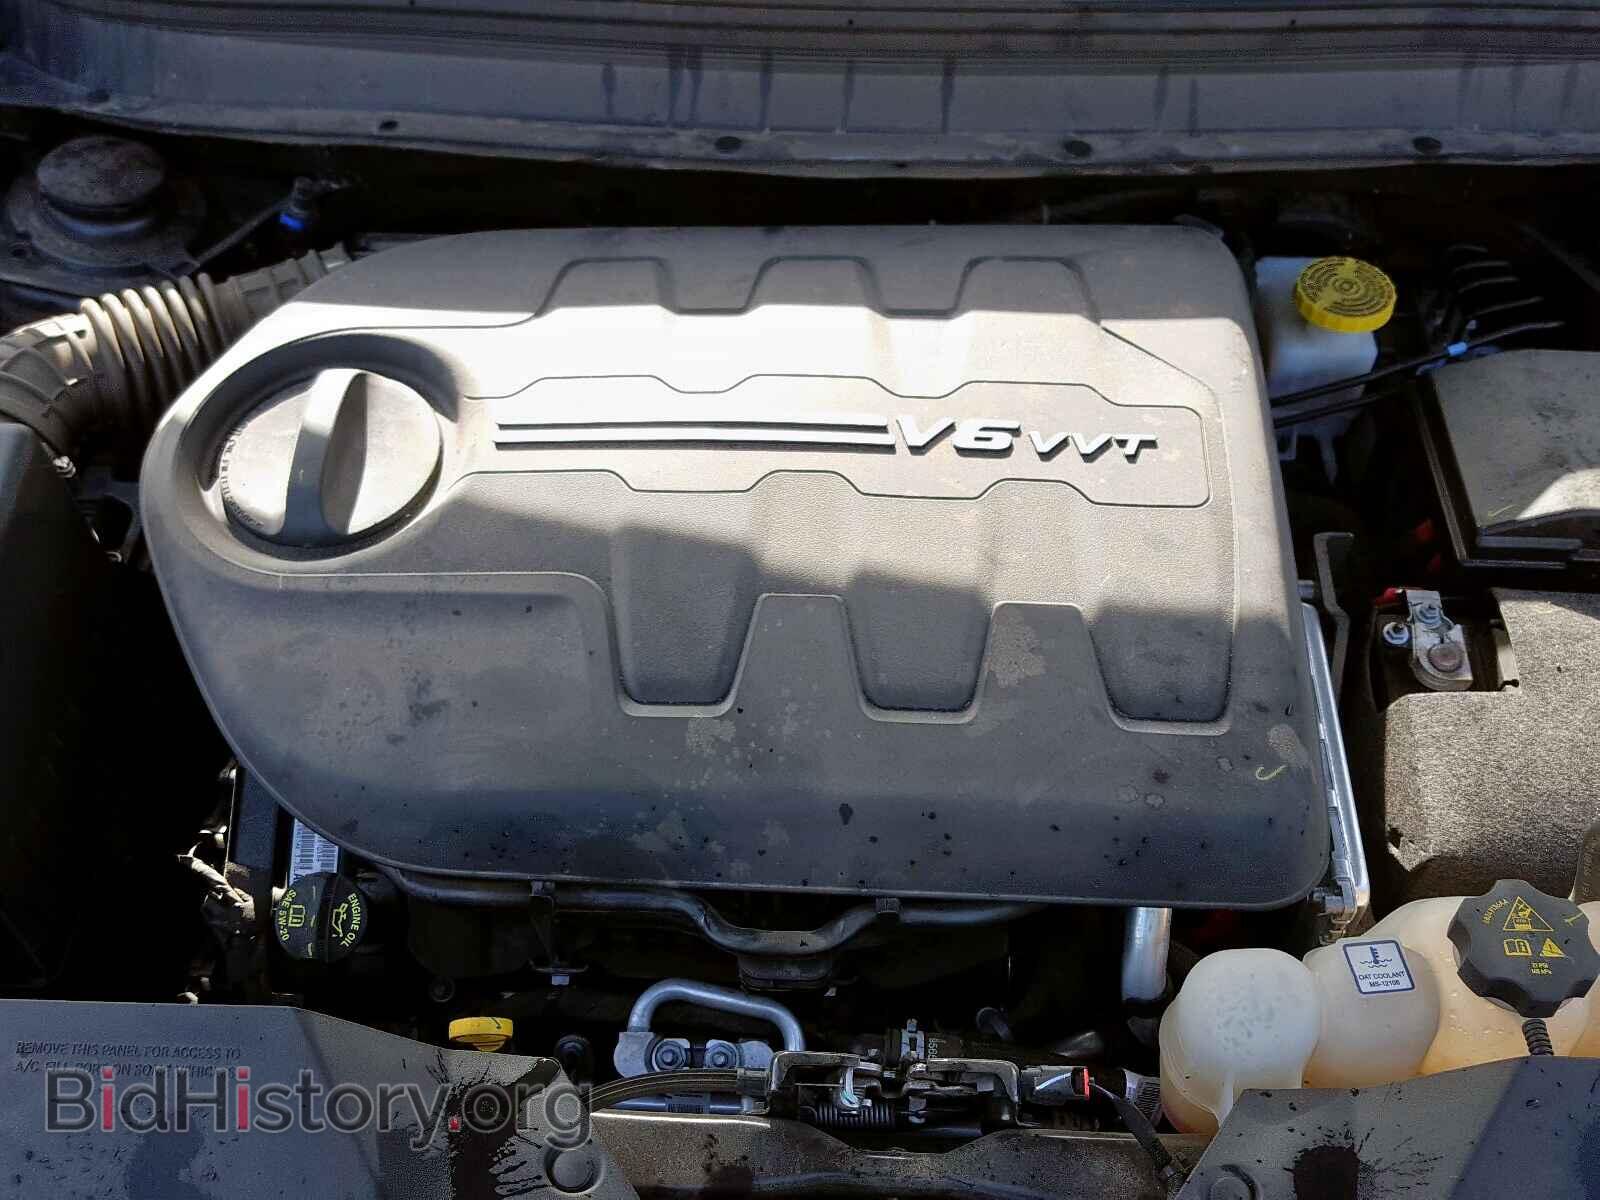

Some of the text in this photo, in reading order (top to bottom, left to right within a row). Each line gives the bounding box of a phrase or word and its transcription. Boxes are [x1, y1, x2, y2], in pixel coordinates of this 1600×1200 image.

[896, 415, 1159, 463] V6 VVT
[281, 888, 297, 908] SAE
[278, 910, 290, 941] 5W-20
[339, 892, 361, 947] ENGINE OIL
[1373, 970, 1405, 980] COOLANT
[16, 1041, 241, 1061] REMOVE THIS PANEL FOR ACCESS TO
[14, 1059, 40, 1073] A/C
[112, 1063, 131, 1076] ON
